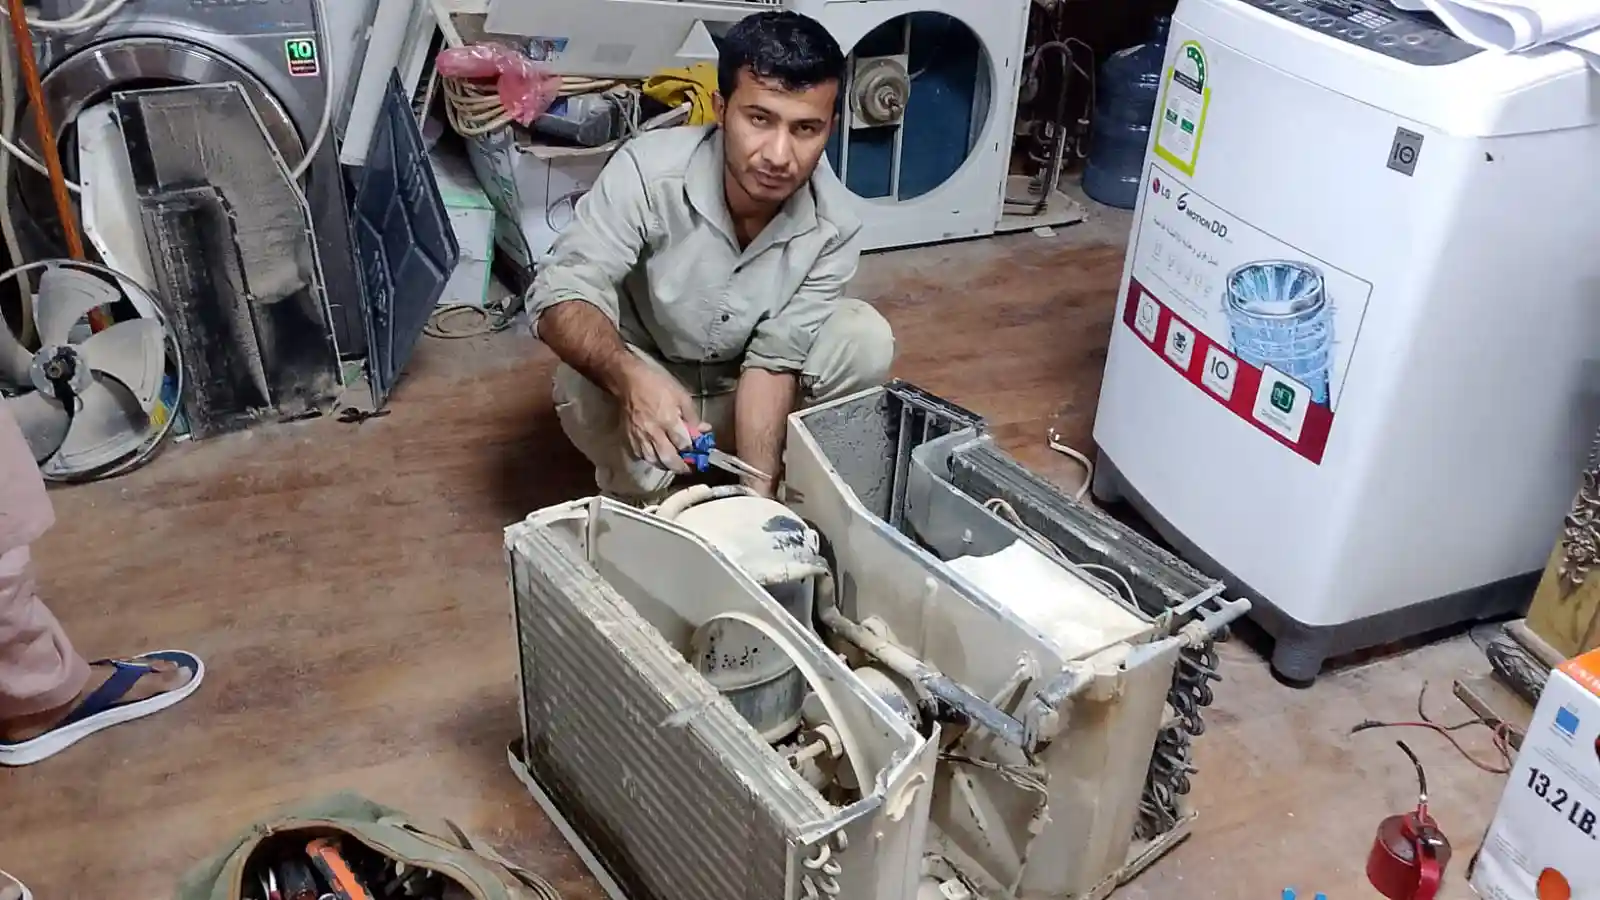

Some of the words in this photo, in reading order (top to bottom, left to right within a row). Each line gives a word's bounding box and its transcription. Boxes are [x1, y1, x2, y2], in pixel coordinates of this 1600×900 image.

[289, 41, 312, 58] 10
[1161, 185, 1171, 199] LG
[1176, 192, 1190, 211] 6
[1186, 208, 1210, 230] MOTION
[1211, 220, 1228, 238] DD
[1527, 766, 1568, 813] 13.2
[1568, 800, 1597, 840] LB.
